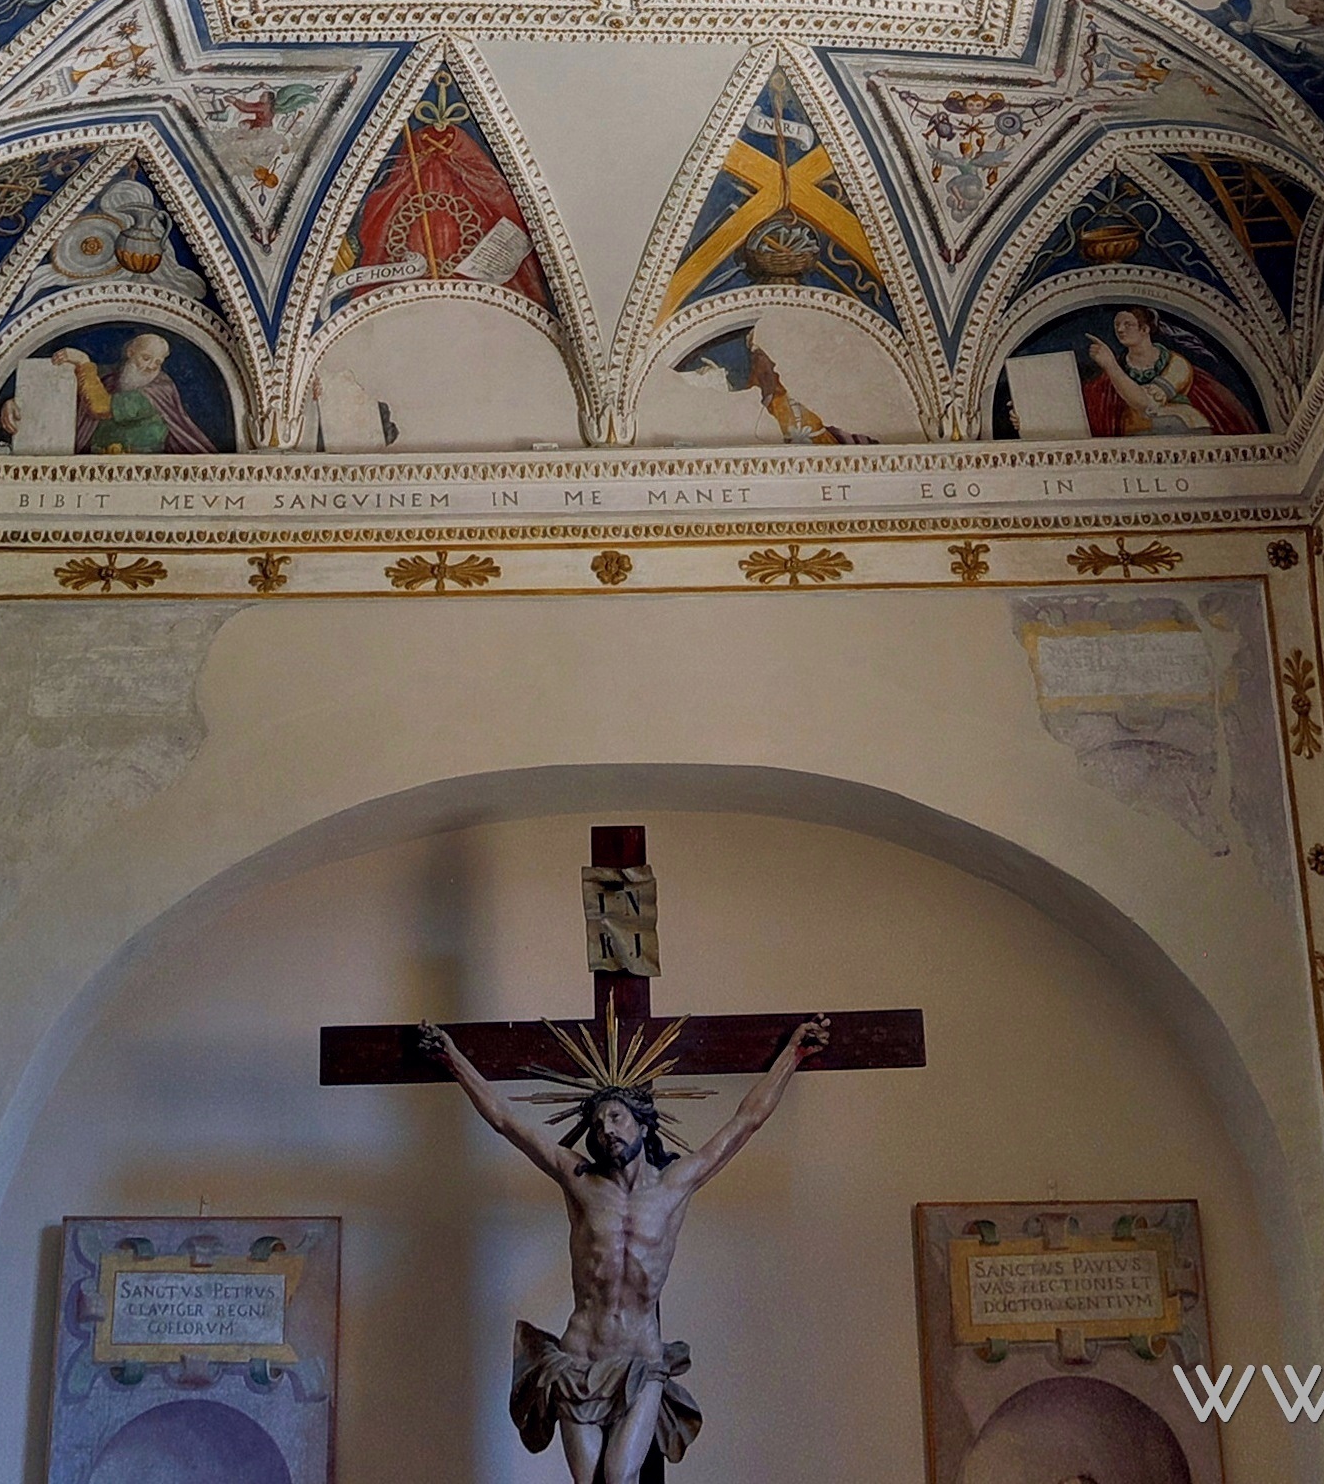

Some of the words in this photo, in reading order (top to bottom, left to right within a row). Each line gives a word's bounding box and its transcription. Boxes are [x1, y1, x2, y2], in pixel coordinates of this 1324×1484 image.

[326, 271, 365, 296] ECCE
[18, 492, 111, 511] BIBIT
[160, 492, 246, 512] MEVM
[272, 490, 452, 510] SANGVINEM
[490, 489, 520, 508] IN
[563, 489, 604, 508] ME
[647, 486, 753, 506] MANET
[820, 483, 852, 503] ET
[920, 480, 982, 500] EGO
[1043, 477, 1075, 496] IN
[1122, 475, 1191, 495] ILLO
[974, 1259, 1065, 1279] SANCTVS
[1072, 1256, 1142, 1275] PAVLVS
[120, 1279, 203, 1300] SANCTVS
[212, 1281, 276, 1300] PETRVS
[979, 1279, 1015, 1295] VAS
[1131, 1275, 1153, 1290] ET
[983, 1295, 1060, 1314] DOCTOR
[1065, 1292, 1154, 1311] GENTIVM
